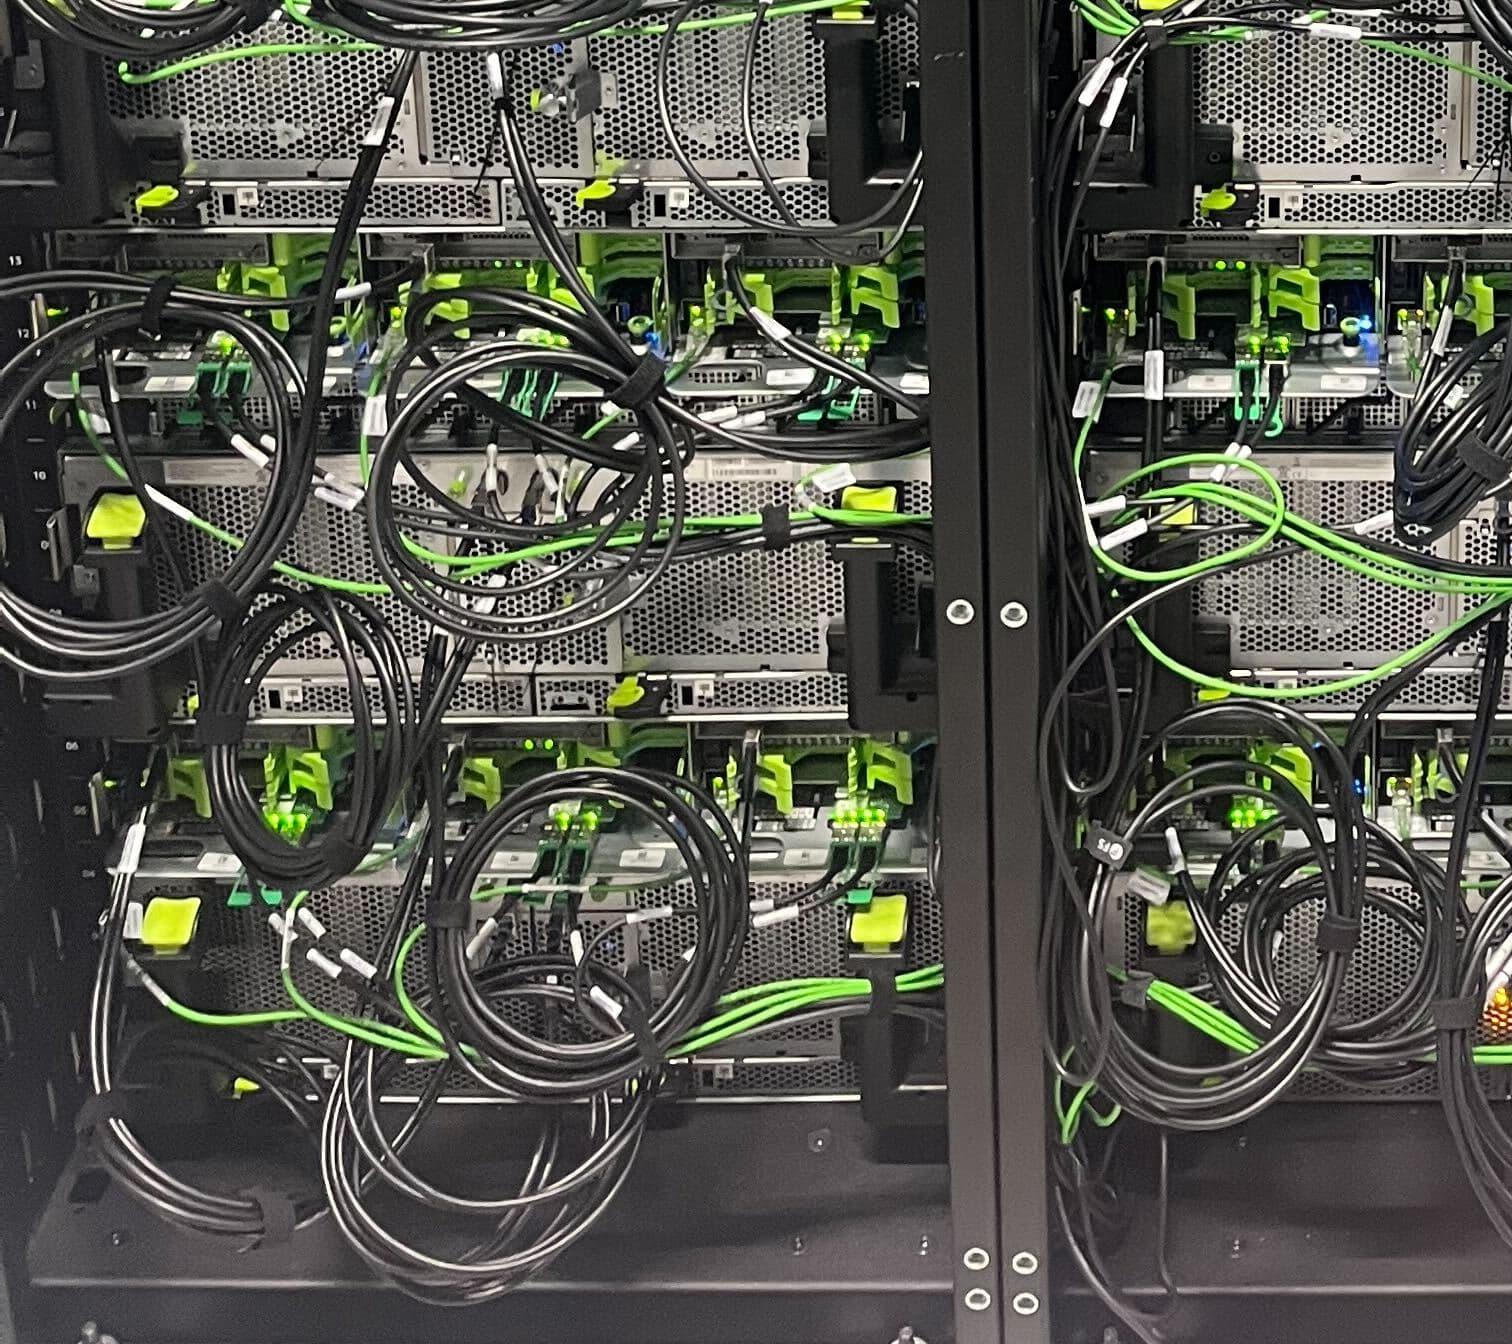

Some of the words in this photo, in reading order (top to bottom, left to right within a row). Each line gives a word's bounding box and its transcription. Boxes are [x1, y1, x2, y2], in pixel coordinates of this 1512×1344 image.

[9, 255, 22, 266] 13
[16, 327, 30, 339] 12
[25, 399, 37, 410] 11
[33, 470, 46, 481] 10
